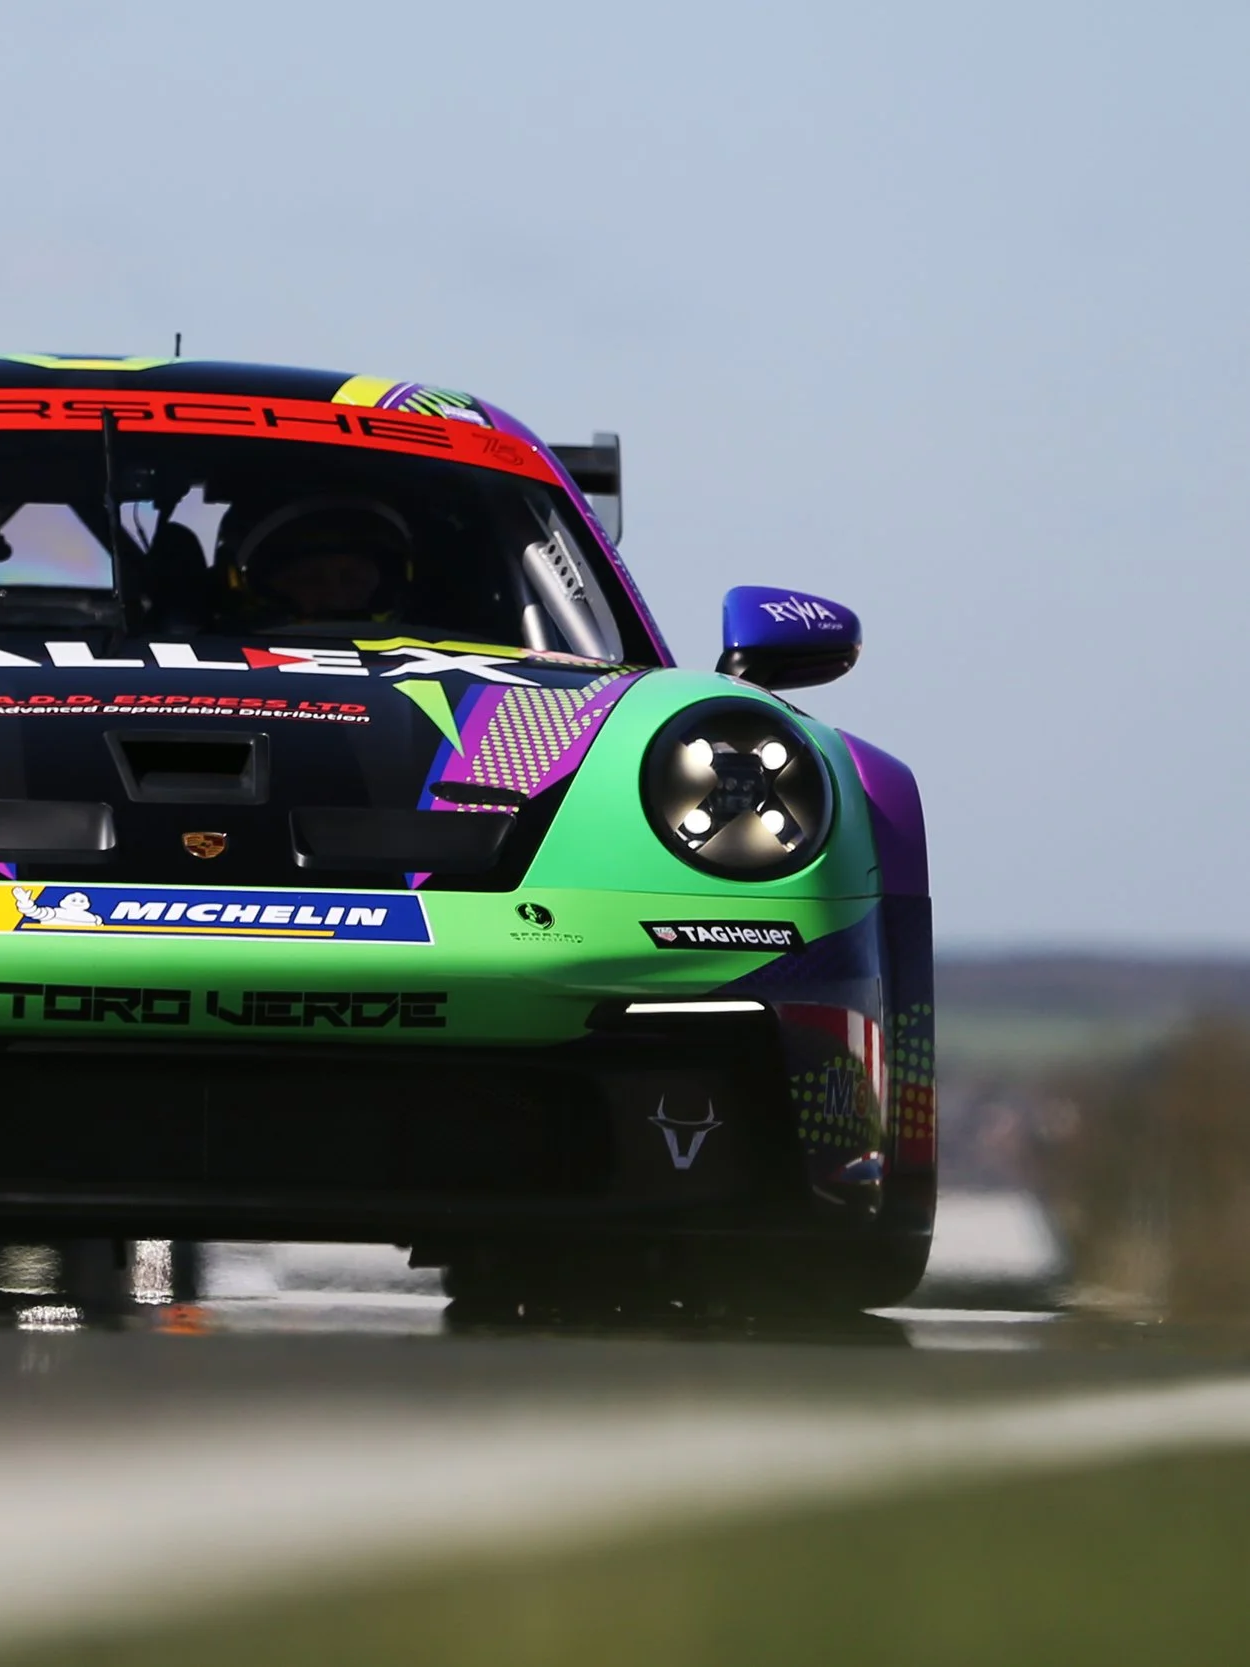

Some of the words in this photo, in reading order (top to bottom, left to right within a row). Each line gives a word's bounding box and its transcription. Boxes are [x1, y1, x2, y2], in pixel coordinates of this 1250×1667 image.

[113, 695, 287, 708] EXPRESS
[298, 701, 367, 713] LTD
[103, 705, 233, 715] Dependable
[239, 708, 371, 723] Distribution
[110, 900, 389, 927] MICHELIN
